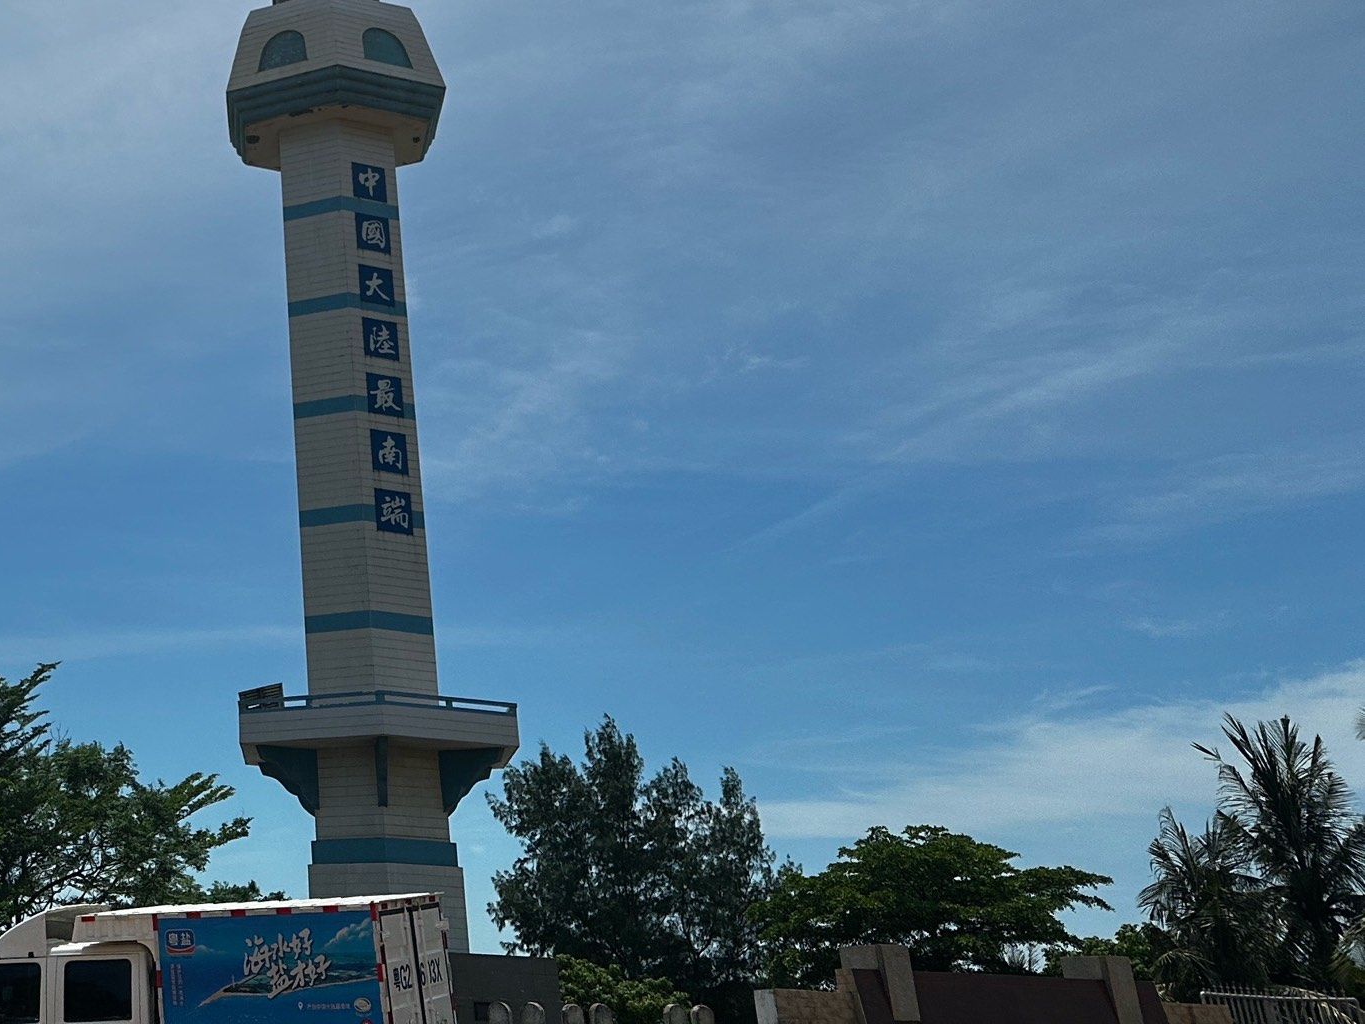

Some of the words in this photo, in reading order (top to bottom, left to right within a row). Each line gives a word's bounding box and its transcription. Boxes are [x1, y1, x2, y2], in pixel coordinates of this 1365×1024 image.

[357, 166, 410, 530] 中國大陸最南端
